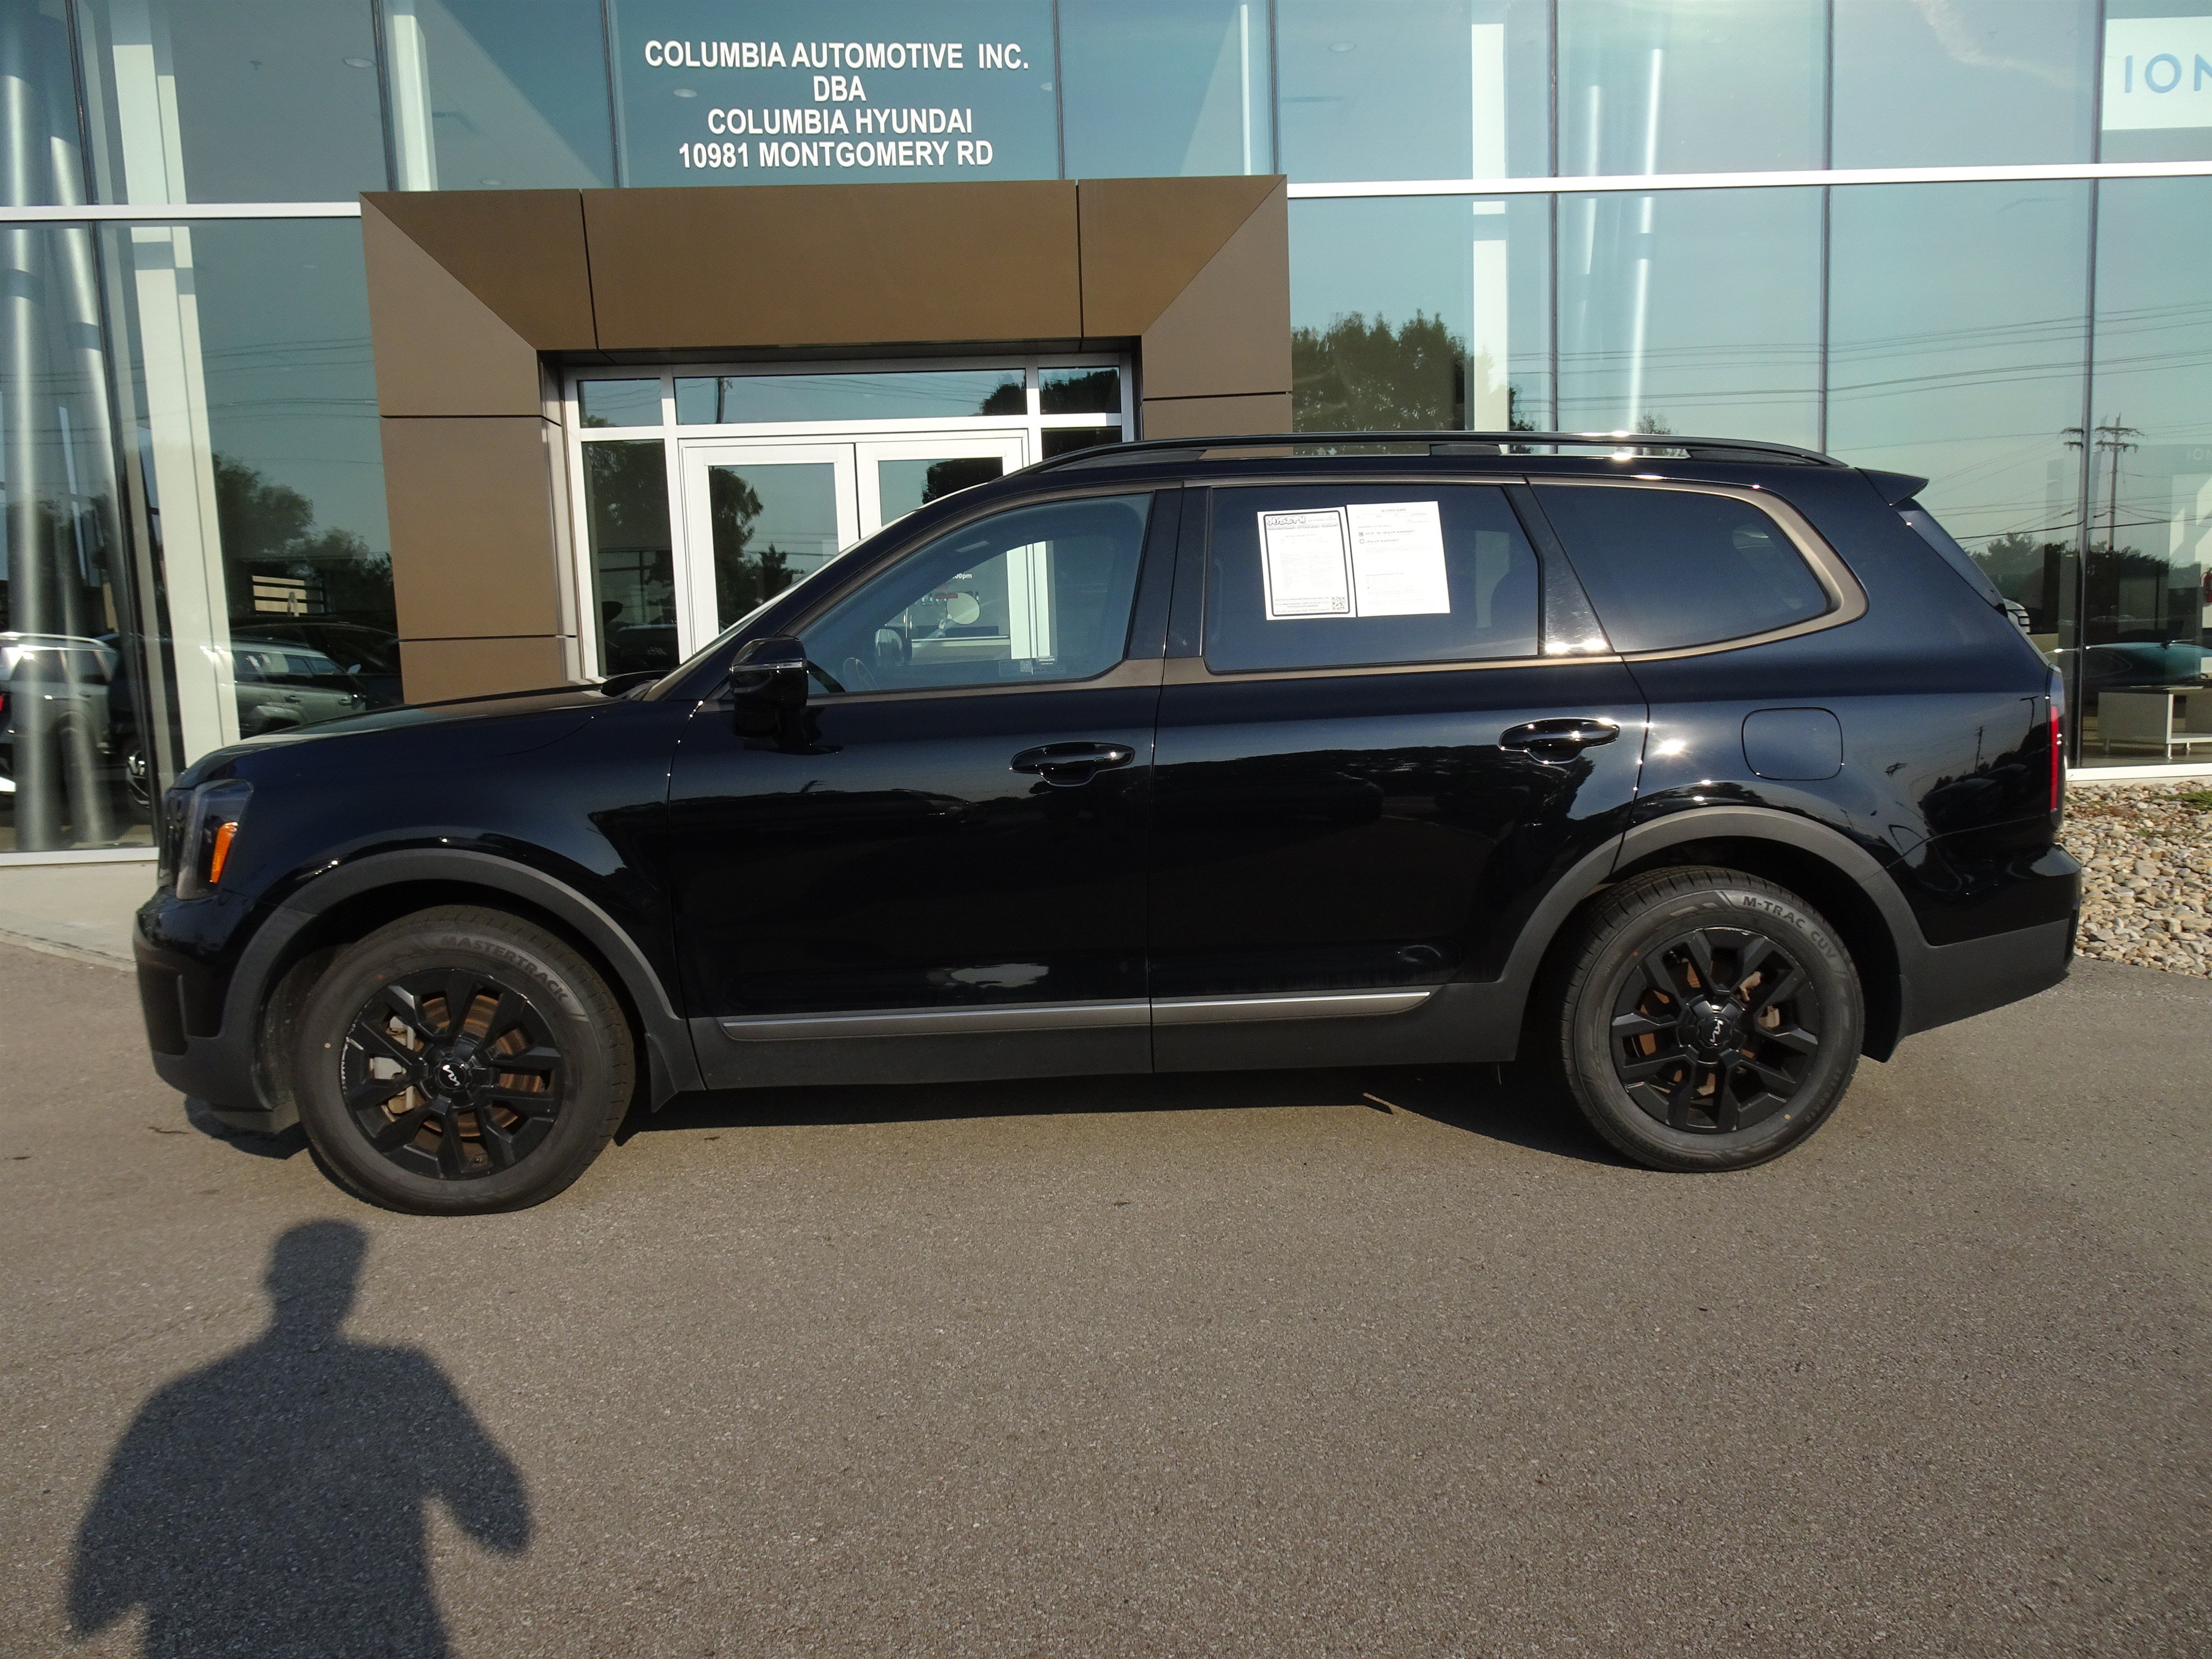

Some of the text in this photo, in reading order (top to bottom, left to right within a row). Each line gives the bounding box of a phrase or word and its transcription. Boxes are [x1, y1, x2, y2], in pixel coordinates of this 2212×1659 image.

[645, 41, 1029, 70] COLUMBIA AUTOMOTIVE INC.
[813, 75, 867, 102] DBA
[707, 108, 973, 134] COLUMBIA HYUNDAI
[678, 140, 993, 168] 10981 MONTGOMERY RD
[1266, 515, 1306, 527] JOSEPH
[1742, 895, 1837, 959] M-TRAC CUV
[440, 935, 568, 1002] MASTERTRACK
